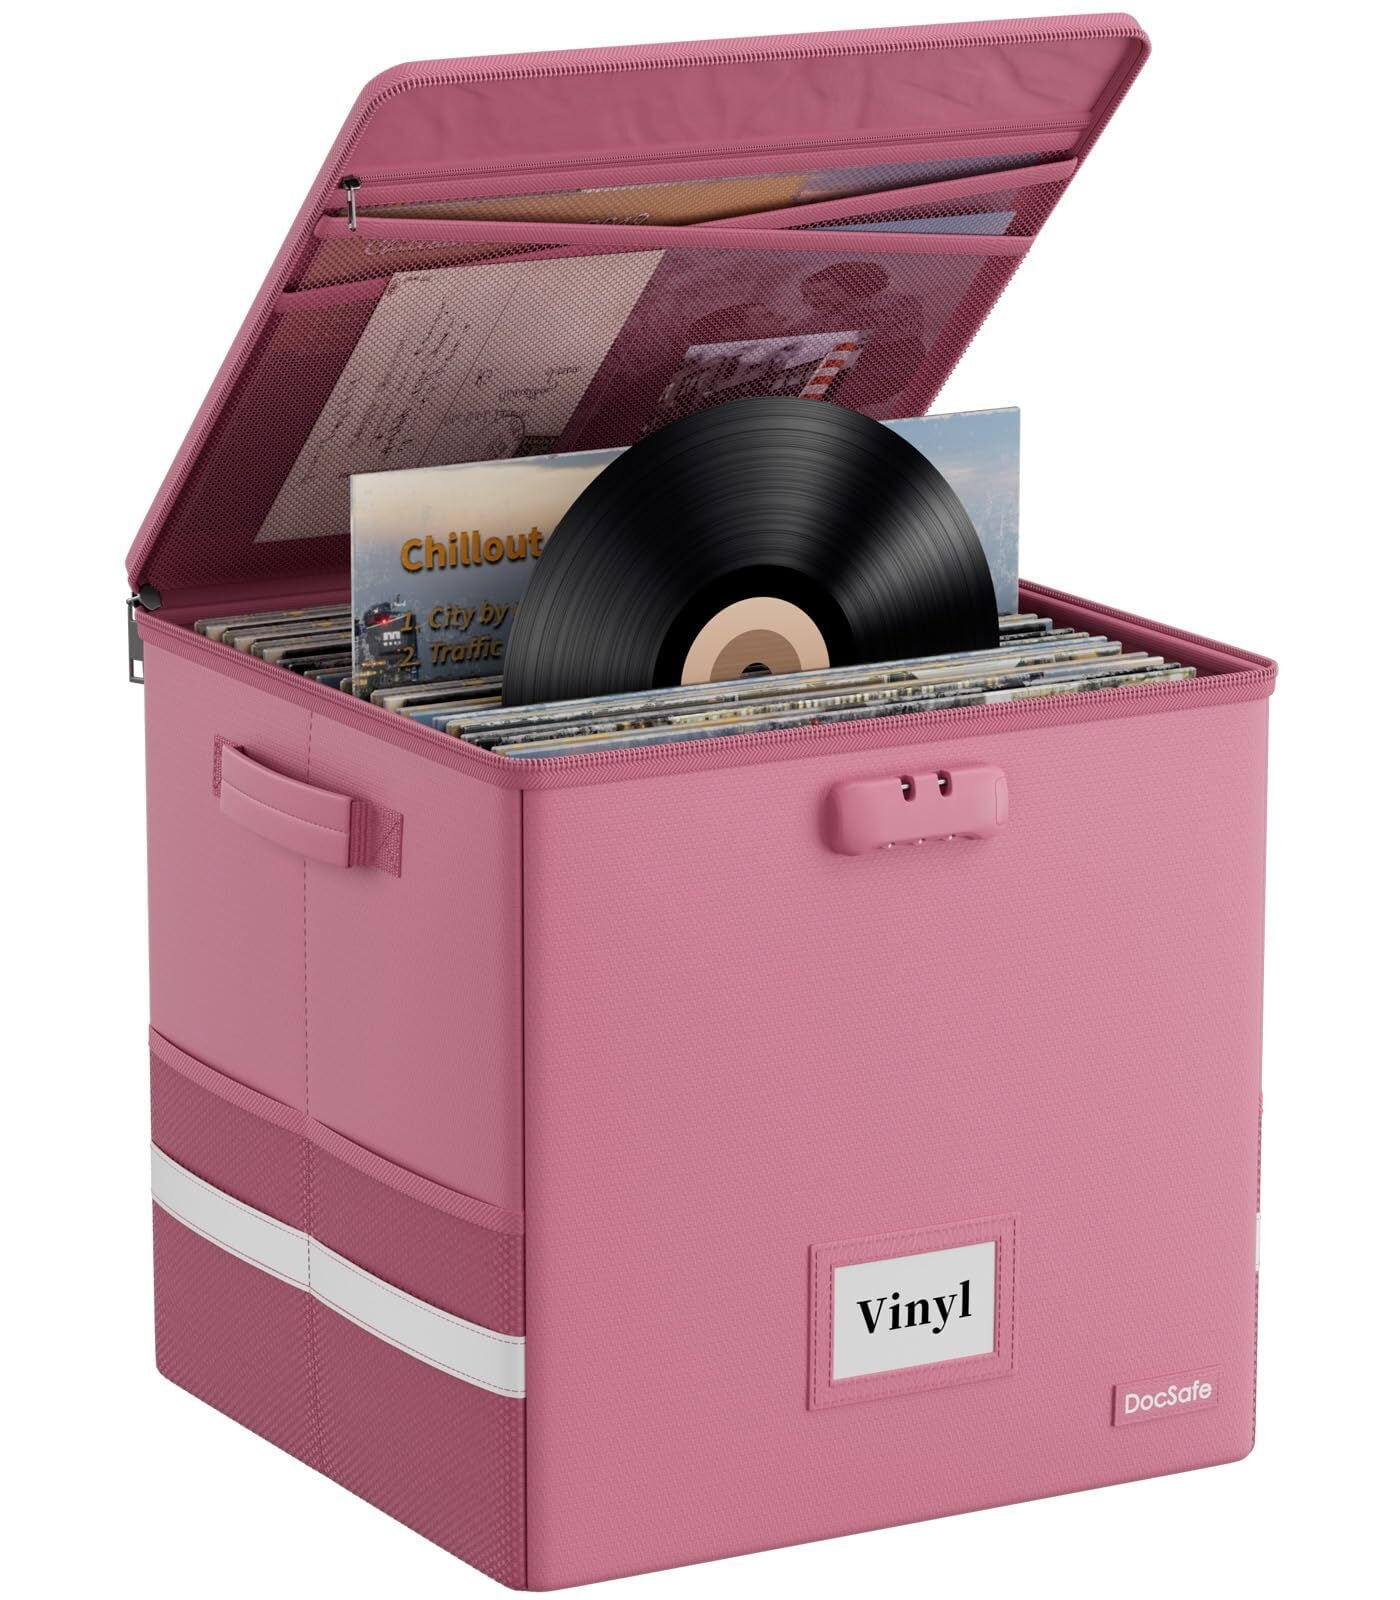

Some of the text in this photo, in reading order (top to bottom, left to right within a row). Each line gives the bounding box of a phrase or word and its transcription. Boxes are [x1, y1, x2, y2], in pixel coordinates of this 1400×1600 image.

[400, 527, 544, 572] Chillout
[400, 611, 421, 633] 1.
[428, 604, 476, 632] City
[480, 600, 510, 628] by
[399, 636, 504, 668] 2. Traffic
[857, 1280, 972, 1335] Vinyl
[1124, 1380, 1212, 1415] DocSafe
